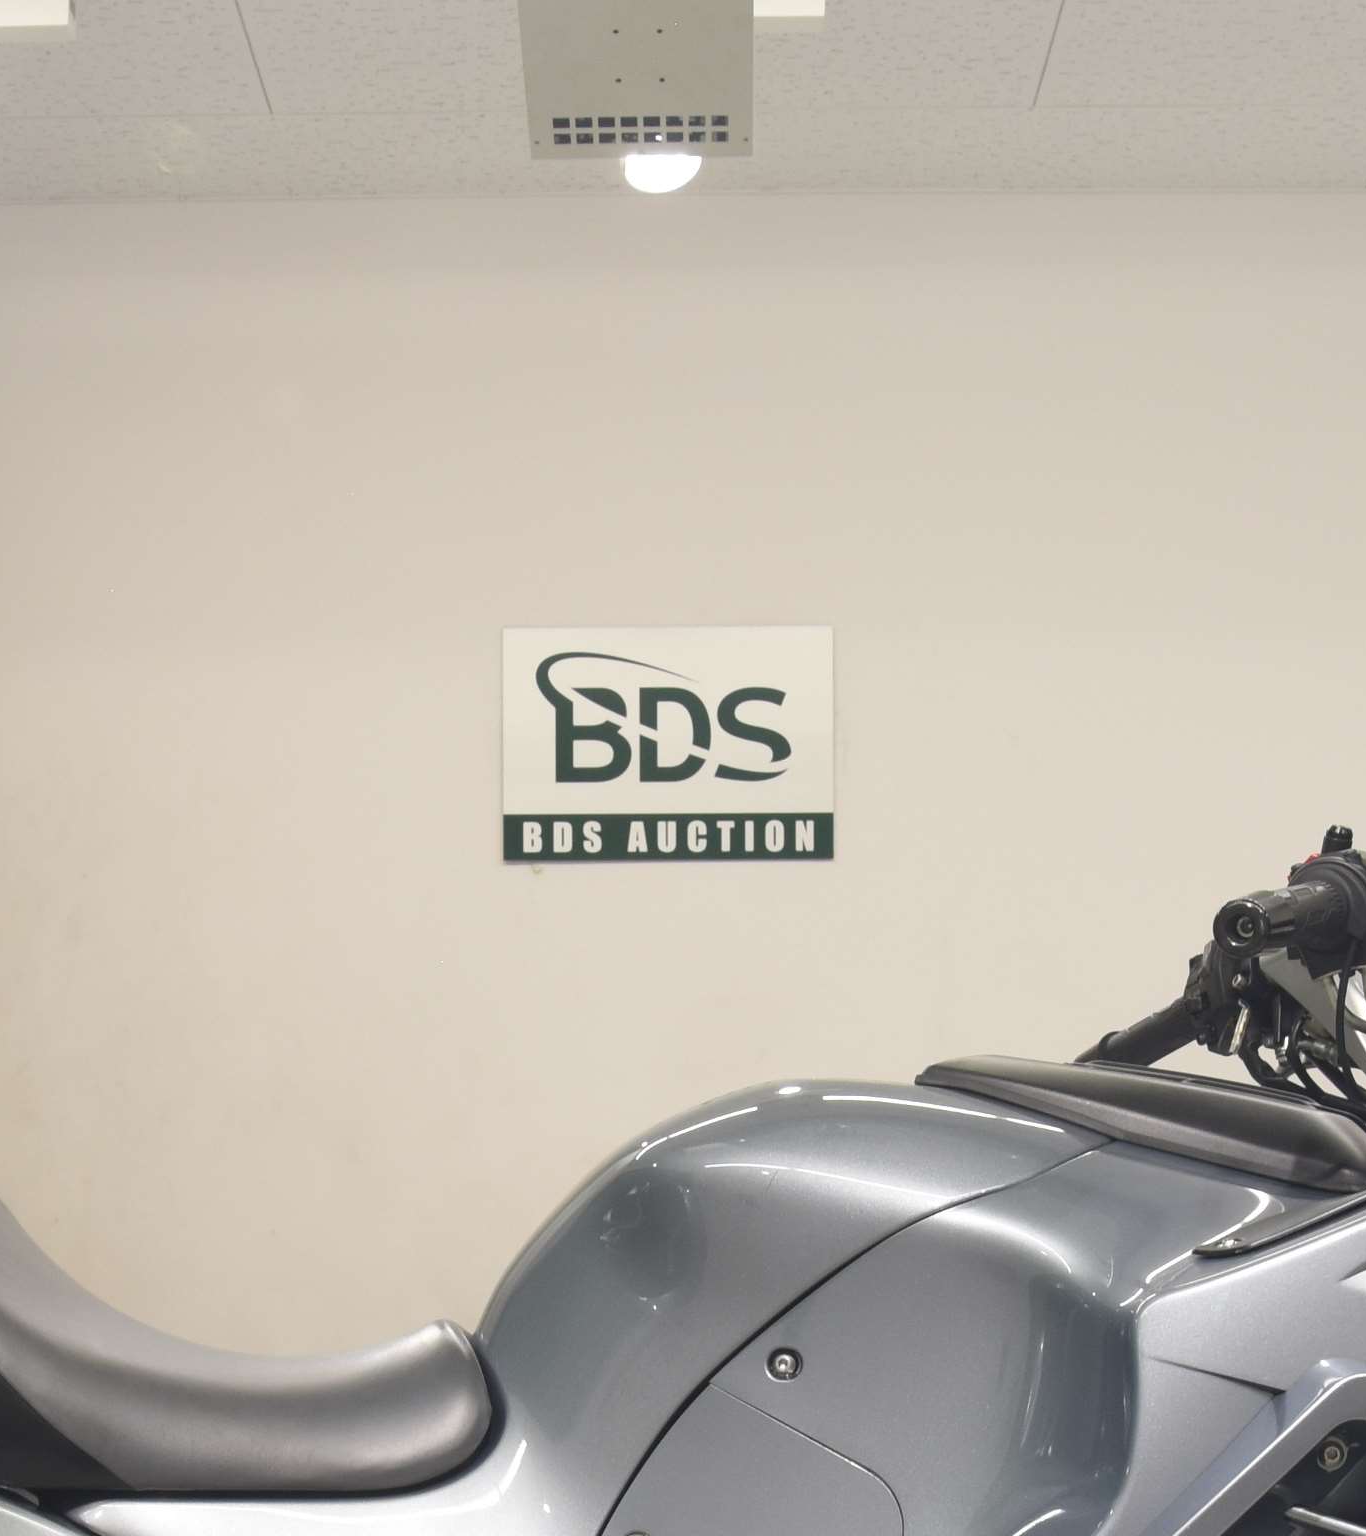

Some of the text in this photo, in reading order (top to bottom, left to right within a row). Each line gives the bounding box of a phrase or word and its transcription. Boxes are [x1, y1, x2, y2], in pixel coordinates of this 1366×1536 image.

[536, 651, 792, 783] BDS
[523, 820, 815, 853] BDS AUCTION
